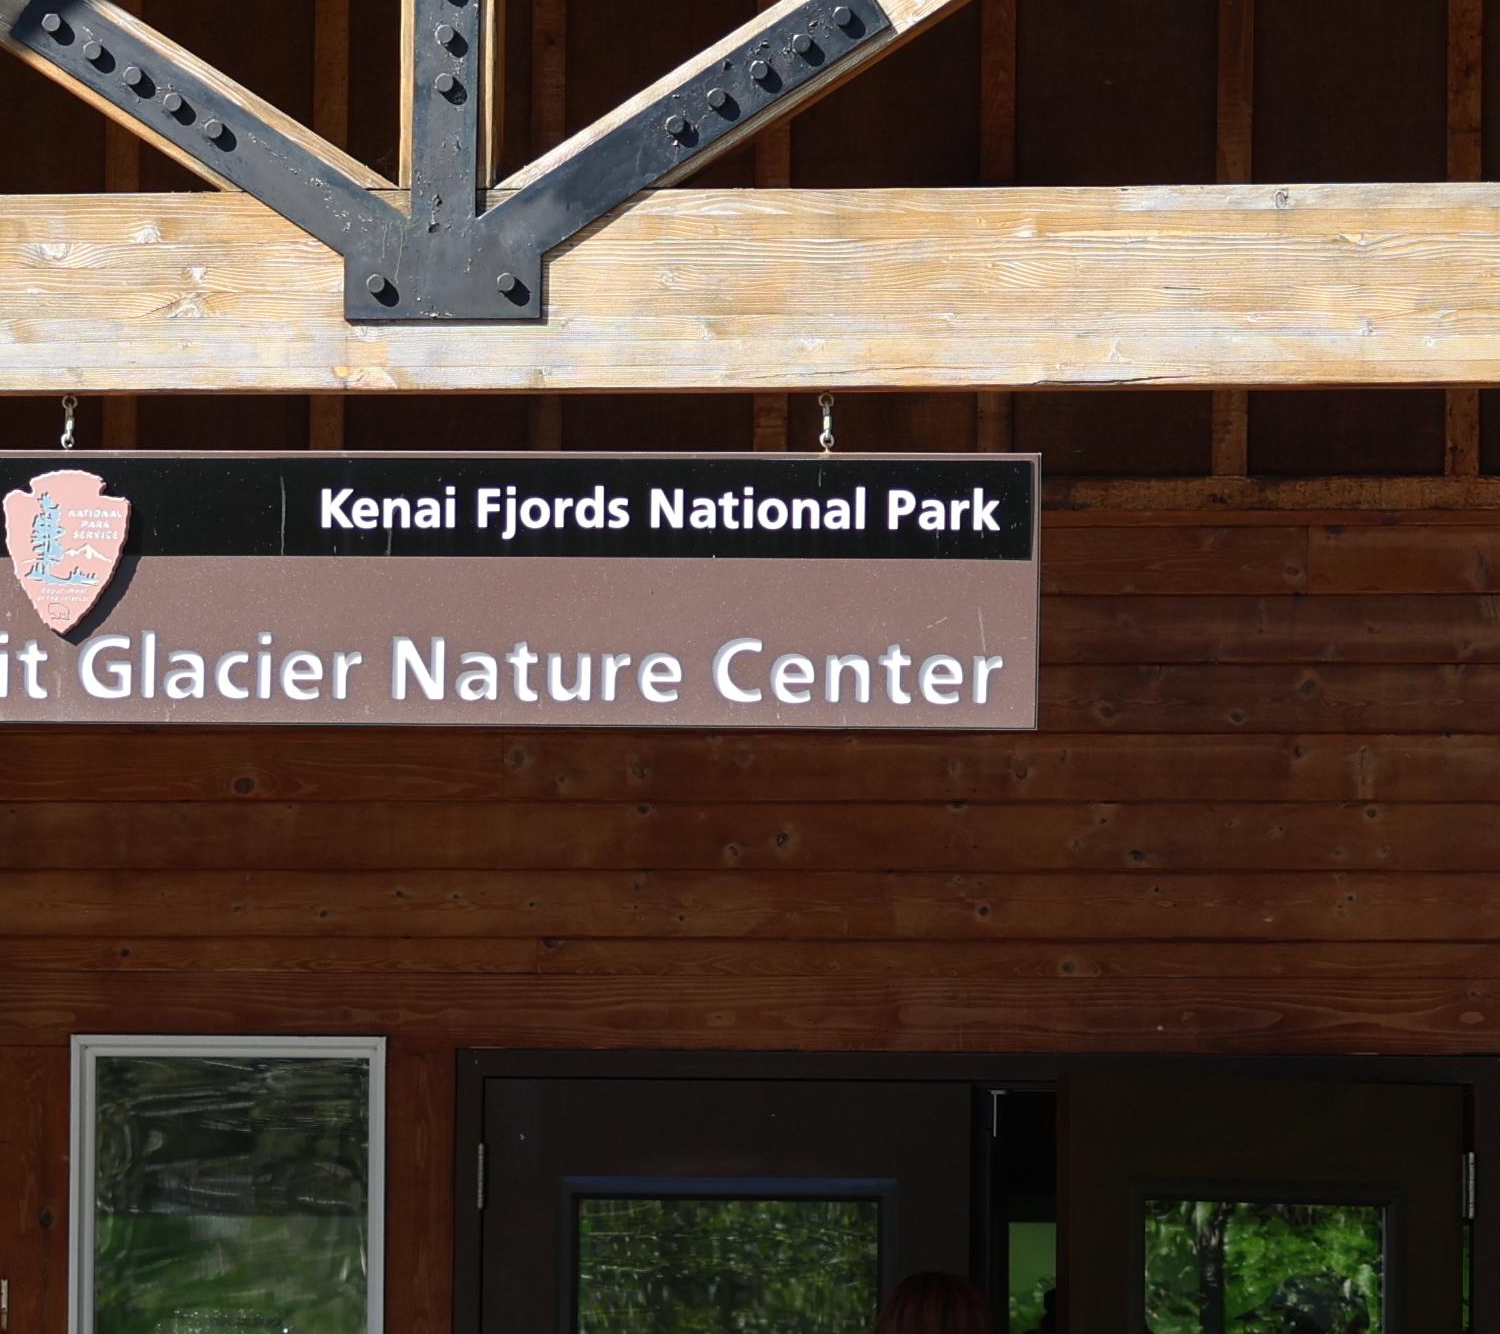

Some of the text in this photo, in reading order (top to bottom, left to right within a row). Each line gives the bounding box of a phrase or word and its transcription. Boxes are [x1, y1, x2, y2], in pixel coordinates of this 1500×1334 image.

[68, 508, 122, 519] NATIONAL
[319, 487, 1001, 539] Kenai Fjords National Park
[80, 520, 110, 529] PARK
[72, 531, 120, 540] SERVICE
[77, 628, 364, 703] Glacier
[391, 634, 684, 704] Nature
[711, 635, 1003, 706] Center
